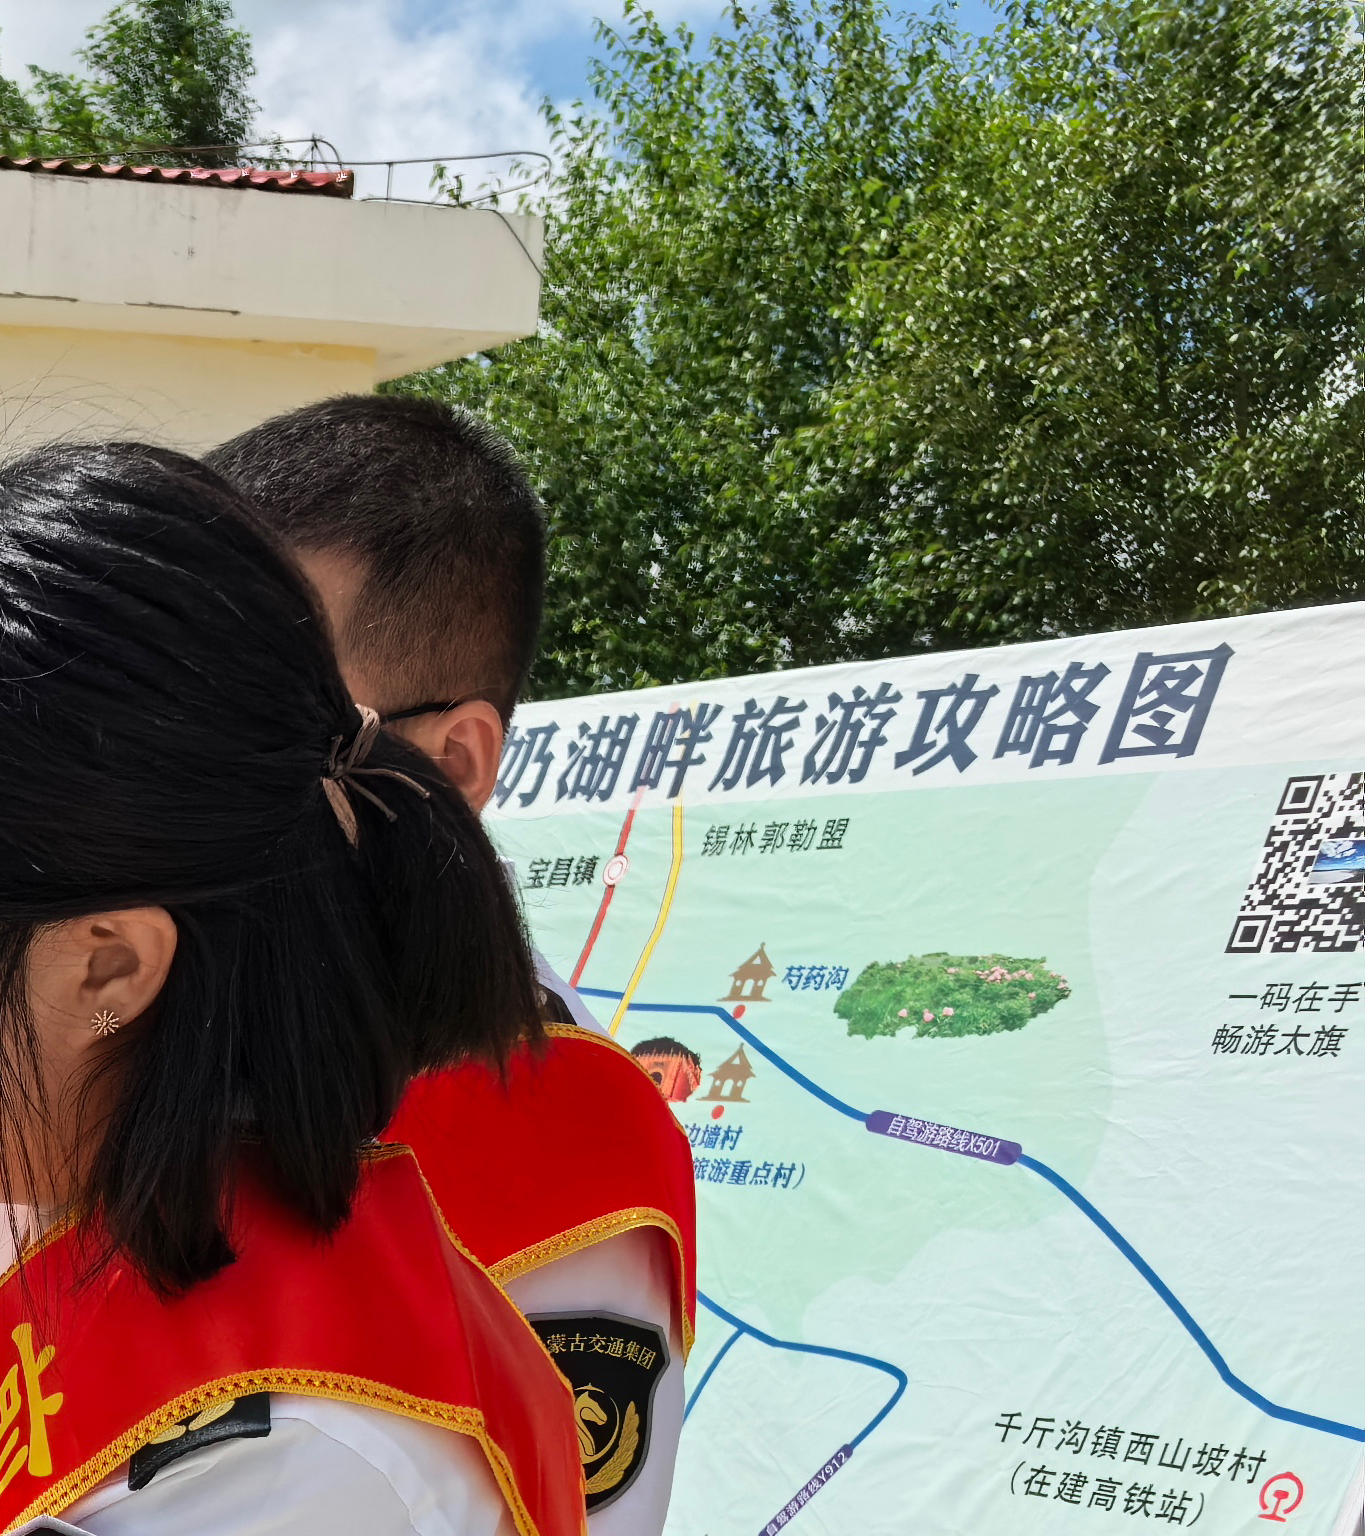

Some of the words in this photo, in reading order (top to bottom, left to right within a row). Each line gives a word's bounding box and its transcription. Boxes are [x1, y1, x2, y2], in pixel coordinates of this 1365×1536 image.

[492, 641, 1236, 808] 奶湖畔旅游攻略图
[701, 818, 850, 857] 锡林郭勒盟
[526, 855, 600, 889] 宝昌镇
[781, 965, 849, 992] 芍药沟
[1228, 982, 1362, 1014] 一码在手
[1211, 1024, 1348, 1058] 畅游太旗
[886, 1113, 1001, 1158] 自驾游路线X501
[995, 1412, 1266, 1485] 千斤沟镇西山坡村
[1010, 1460, 1206, 1528] （在建高铁站）
